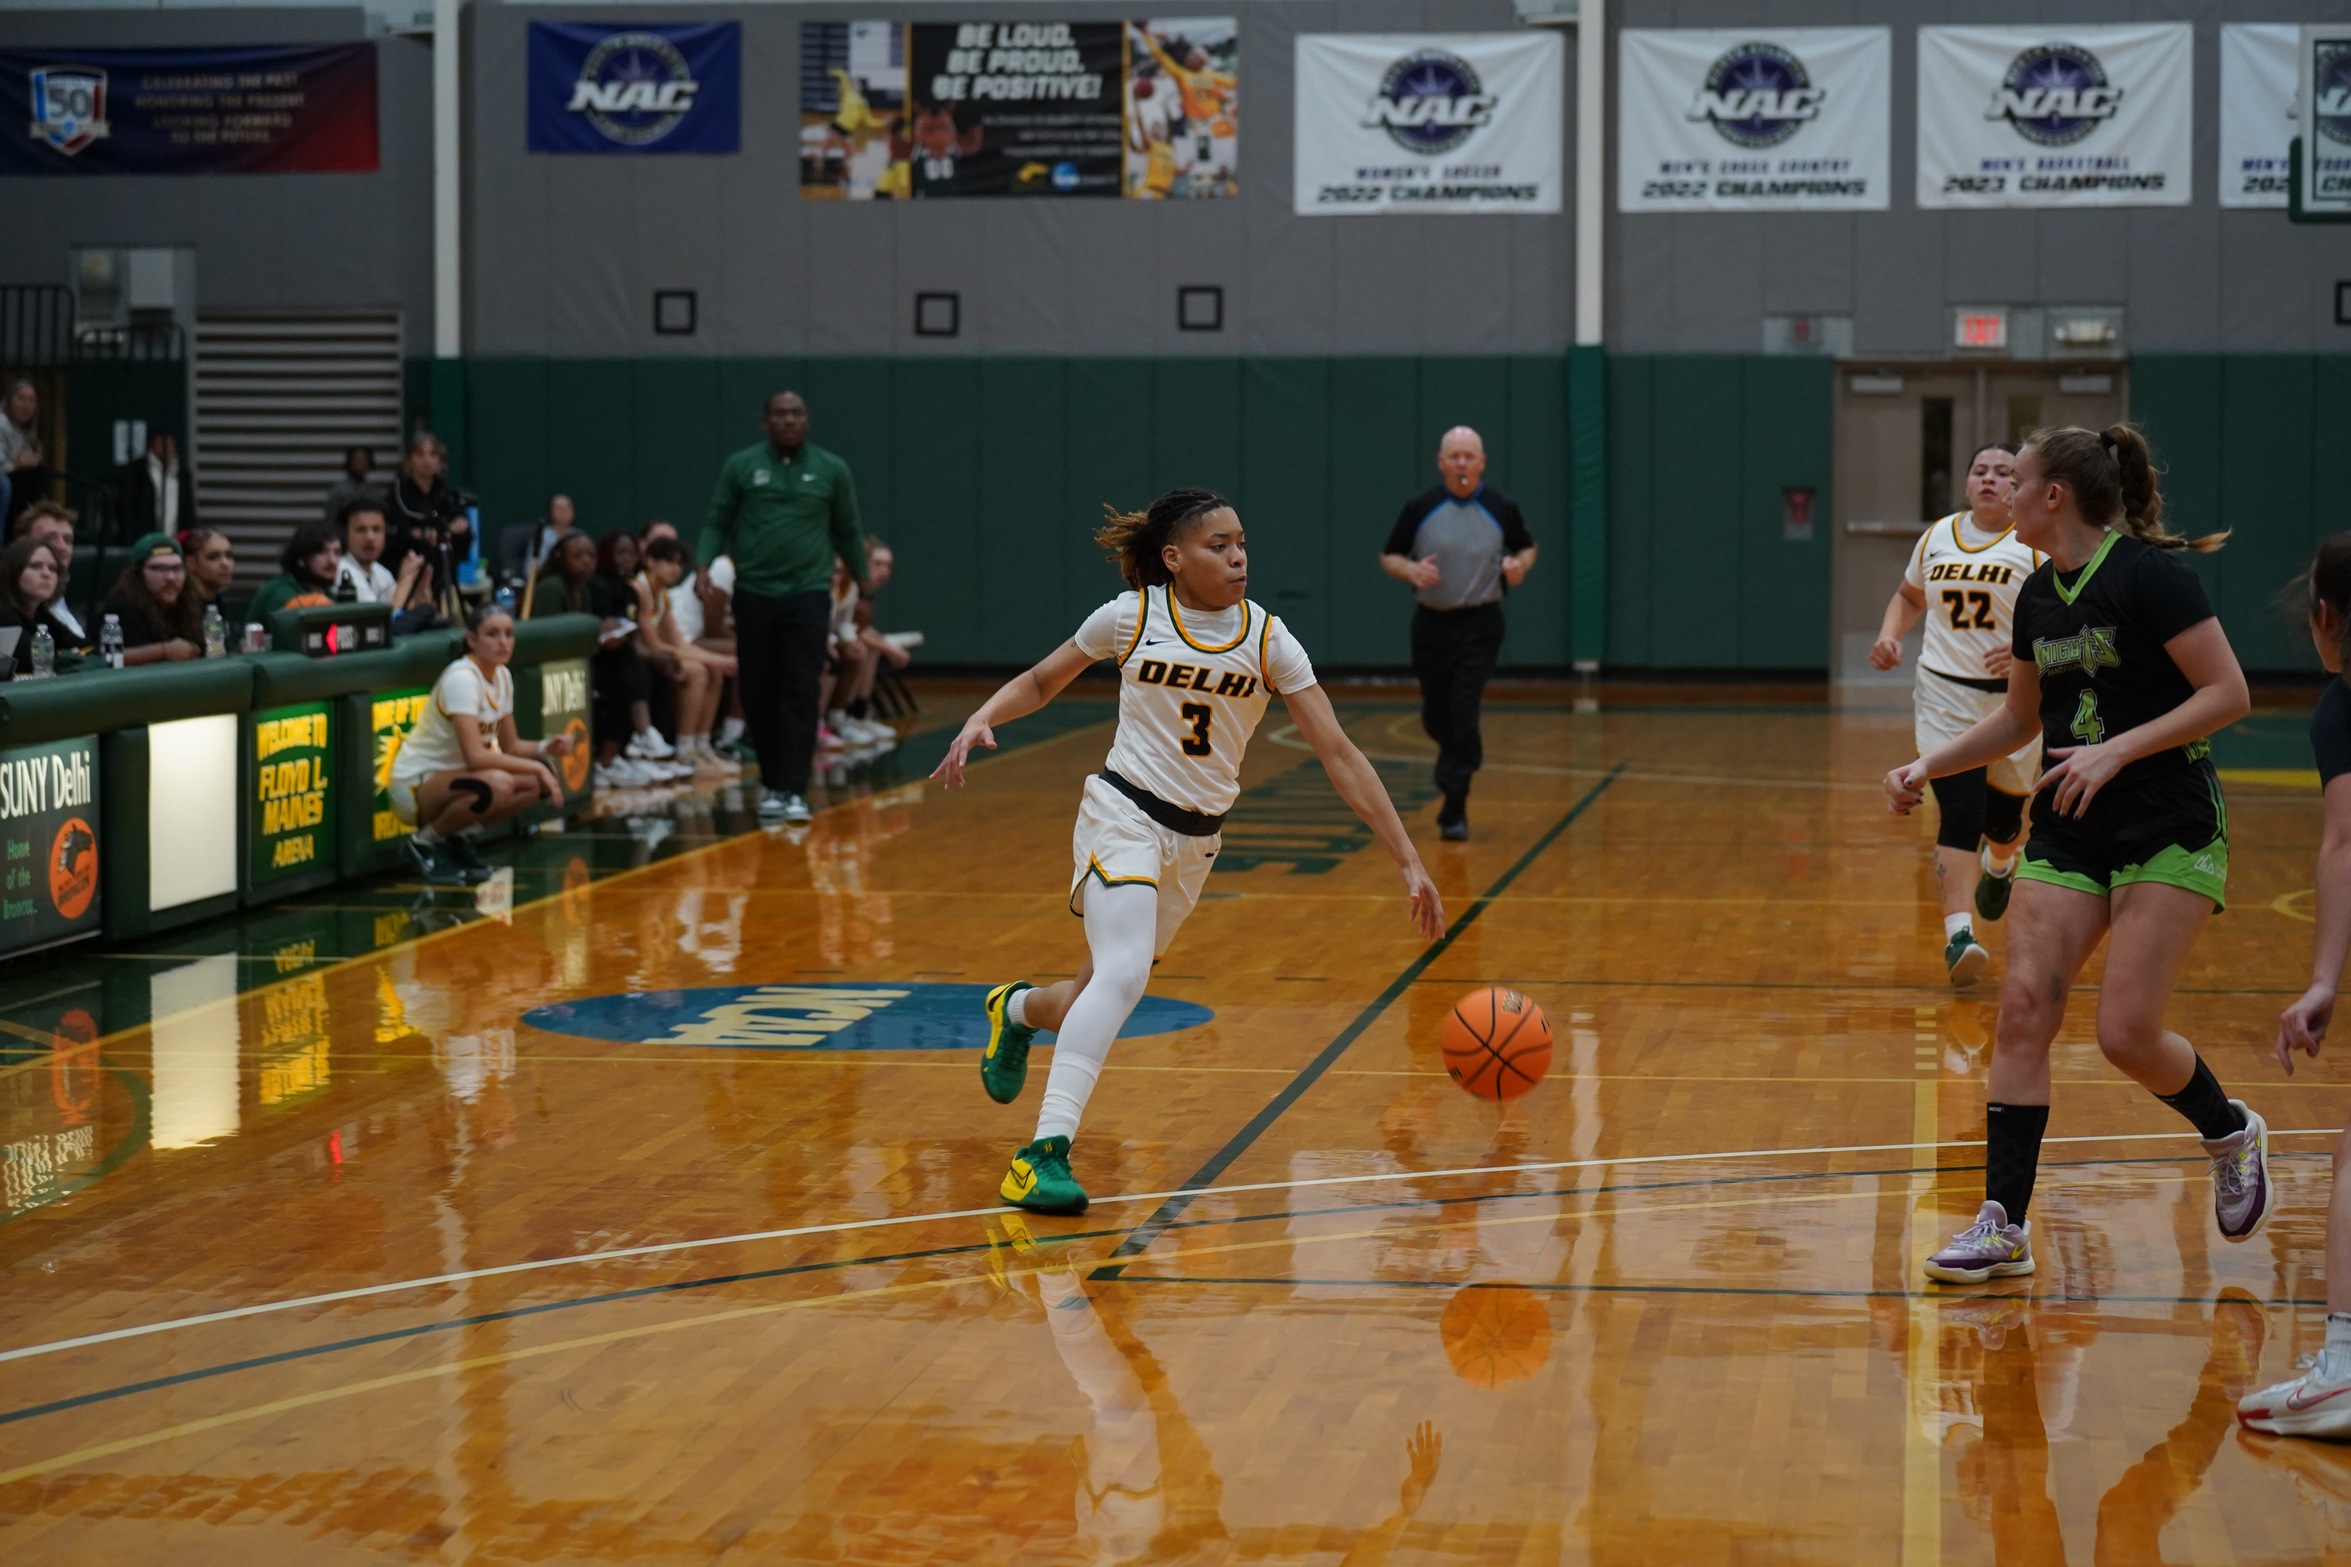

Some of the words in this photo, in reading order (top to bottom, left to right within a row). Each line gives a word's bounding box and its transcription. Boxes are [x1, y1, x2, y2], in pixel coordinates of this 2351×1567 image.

[956, 22, 993, 47] BE
[996, 22, 1075, 47] LOUD.
[945, 48, 984, 73] BE
[986, 48, 1086, 73] PROUD.
[49, 88, 90, 118] 50
[565, 79, 700, 112] NAC
[931, 74, 969, 100] BE
[970, 73, 1103, 100] POSITIVE!
[1983, 86, 2122, 122] NAC
[1360, 95, 1498, 129] NAC
[1684, 87, 1827, 122] NAC
[1317, 184, 1383, 202] 2022
[1389, 182, 1540, 202] CHAMPIONS
[1642, 180, 1708, 198] 2022
[1715, 178, 1868, 198] CHAMPIONS
[1943, 175, 2007, 193] 2023
[2018, 172, 2166, 192] CHAMPIONS
[1928, 562, 2014, 586] DELHI
[1941, 589, 1996, 631] 22
[2032, 623, 2121, 679] KNIGHTS
[1136, 657, 1259, 699] DELHI
[1180, 701, 1214, 758] 3
[2069, 687, 2105, 747] 4
[0, 756, 48, 819] SUNY
[51, 750, 91, 810] Delhi
[258, 758, 310, 802] FLOYD
[312, 754, 329, 791] L.
[262, 790, 325, 836] MAINES
[272, 833, 315, 869] ARENA
